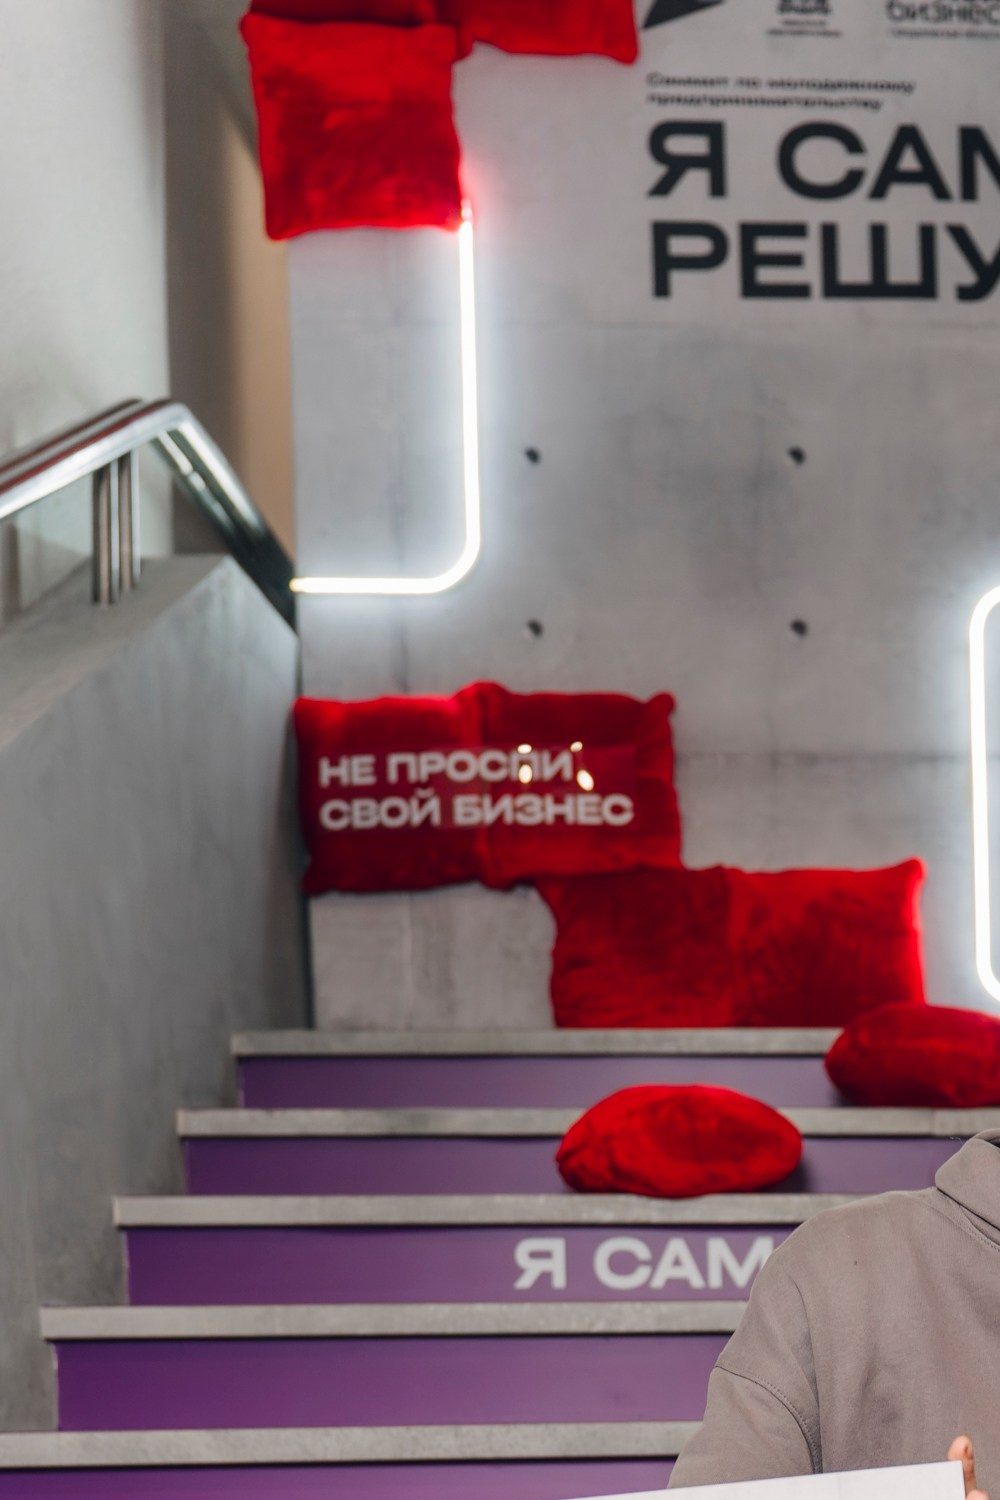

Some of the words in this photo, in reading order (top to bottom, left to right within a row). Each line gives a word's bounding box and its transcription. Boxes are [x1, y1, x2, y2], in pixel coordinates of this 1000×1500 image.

[648, 120, 726, 198] Я
[319, 754, 377, 787] НЕ
[387, 748, 573, 785] ПРОСПИ
[320, 788, 442, 830] СВОЙ
[453, 793, 634, 826] БИЗНЕС
[514, 1237, 566, 1290] Я
[594, 1237, 774, 1290] САМ
